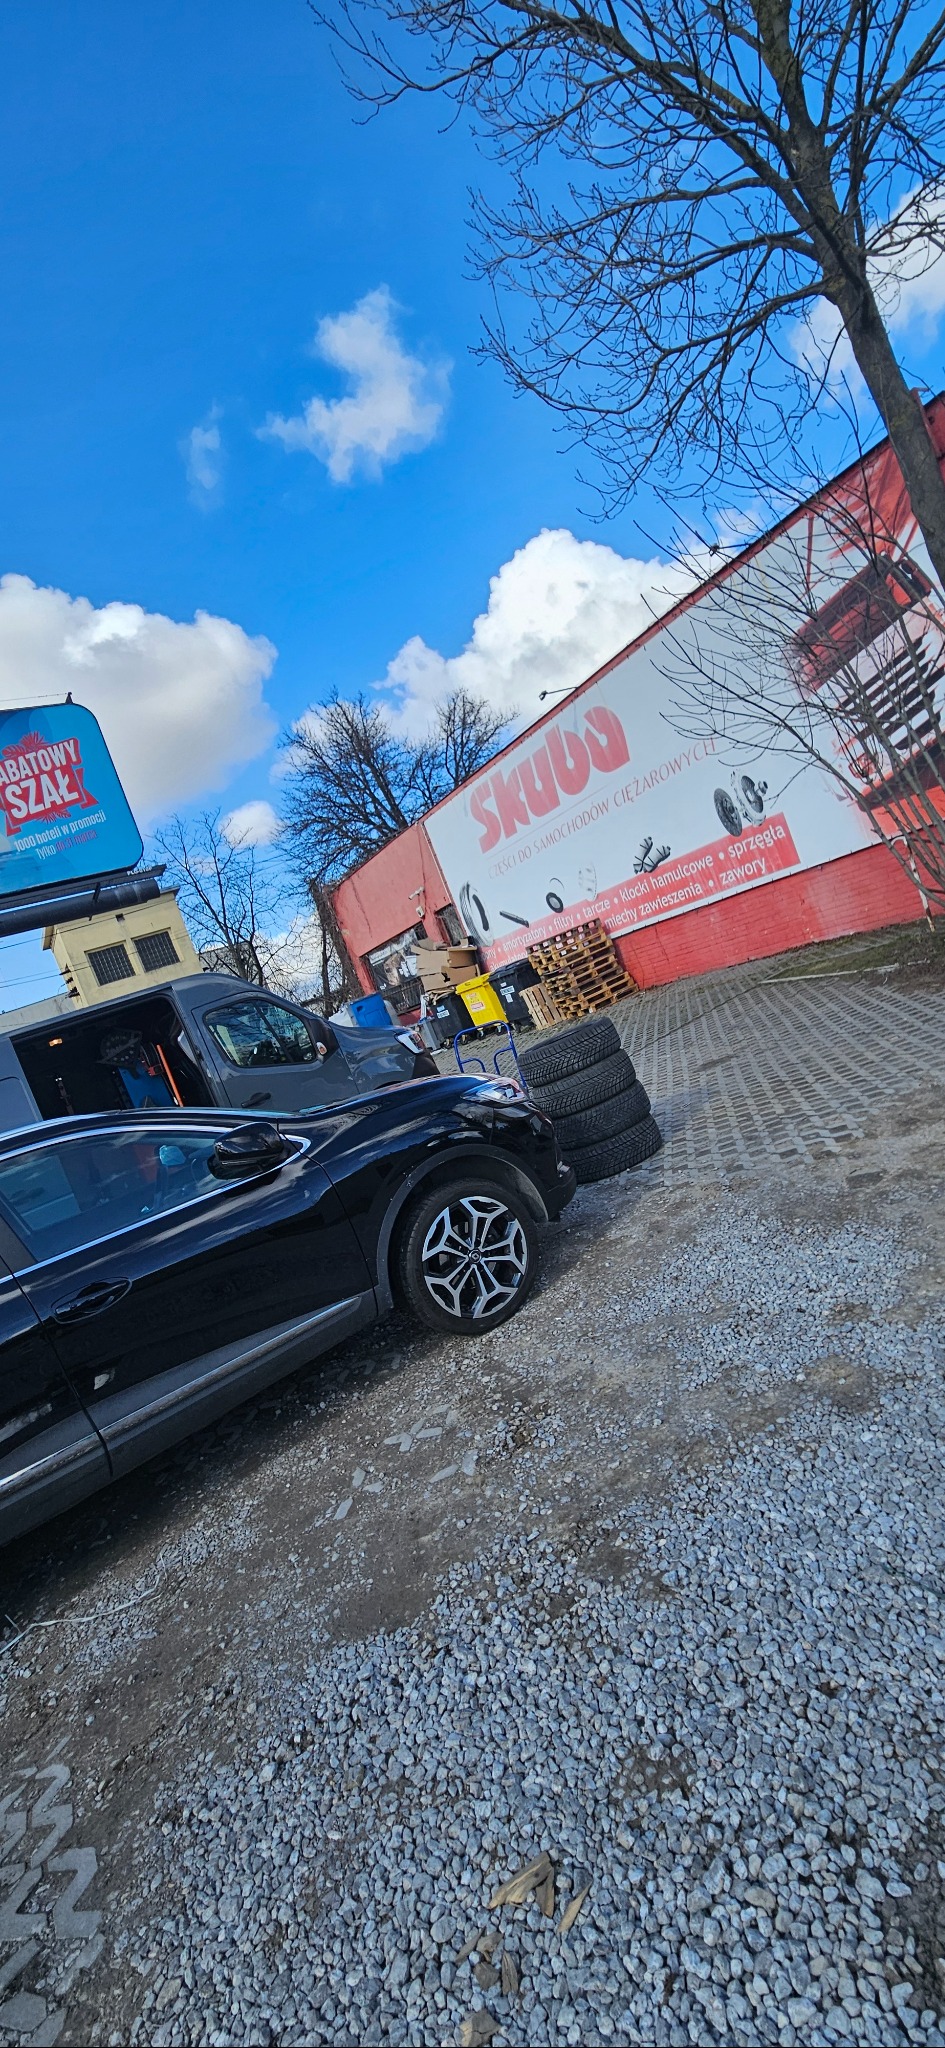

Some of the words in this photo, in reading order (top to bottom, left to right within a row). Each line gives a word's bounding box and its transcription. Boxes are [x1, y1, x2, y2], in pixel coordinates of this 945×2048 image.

[5, 769, 79, 819] SZAŁ
[488, 854, 517, 879] CZĘŚCI
[517, 845, 532, 863] DO
[533, 798, 609, 854] SAMOCHODÓW
[613, 738, 716, 808] CIĘŻAROWYCH
[14, 835, 36, 852] 1000
[35, 826, 62, 845] hoteli
[61, 824, 70, 835] w
[69, 809, 107, 834] promocji
[35, 844, 56, 860] Tylko
[502, 926, 546, 951] amortyzatory
[553, 914, 574, 931] filtry
[582, 899, 611, 918] tarcze
[619, 879, 650, 904] klocki
[650, 855, 714, 890] hamulcowe
[728, 824, 786, 859] sprzęgła
[604, 905, 637, 929] miechy
[638, 882, 703, 916] zawieszenia
[719, 857, 766, 885] zawory
